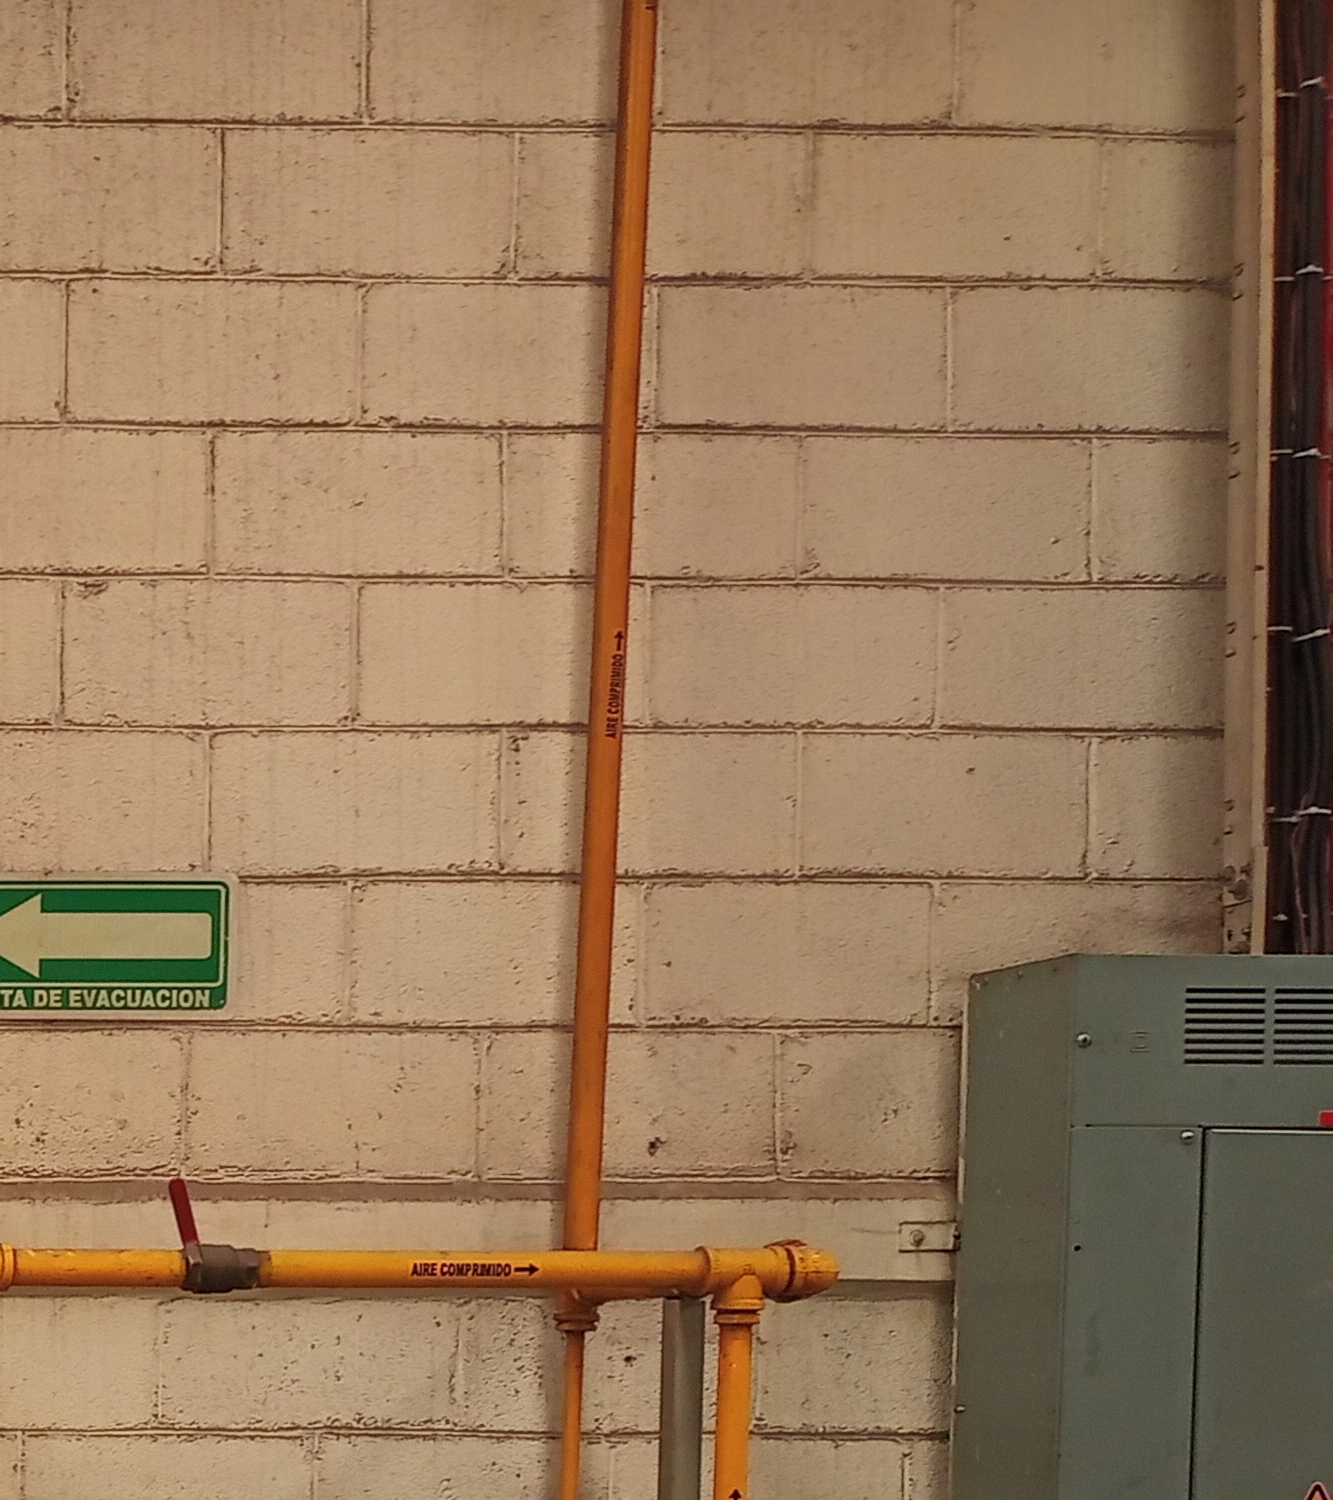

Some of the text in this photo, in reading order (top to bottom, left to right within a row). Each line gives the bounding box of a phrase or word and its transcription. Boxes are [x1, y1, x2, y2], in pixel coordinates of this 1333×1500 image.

[605, 653, 624, 739] AIRE COMPRIMIDO
[34, 989, 62, 1008] DE
[68, 989, 210, 1008] EVACUACION
[411, 1263, 512, 1277] AIRE COMPRIMIDO
